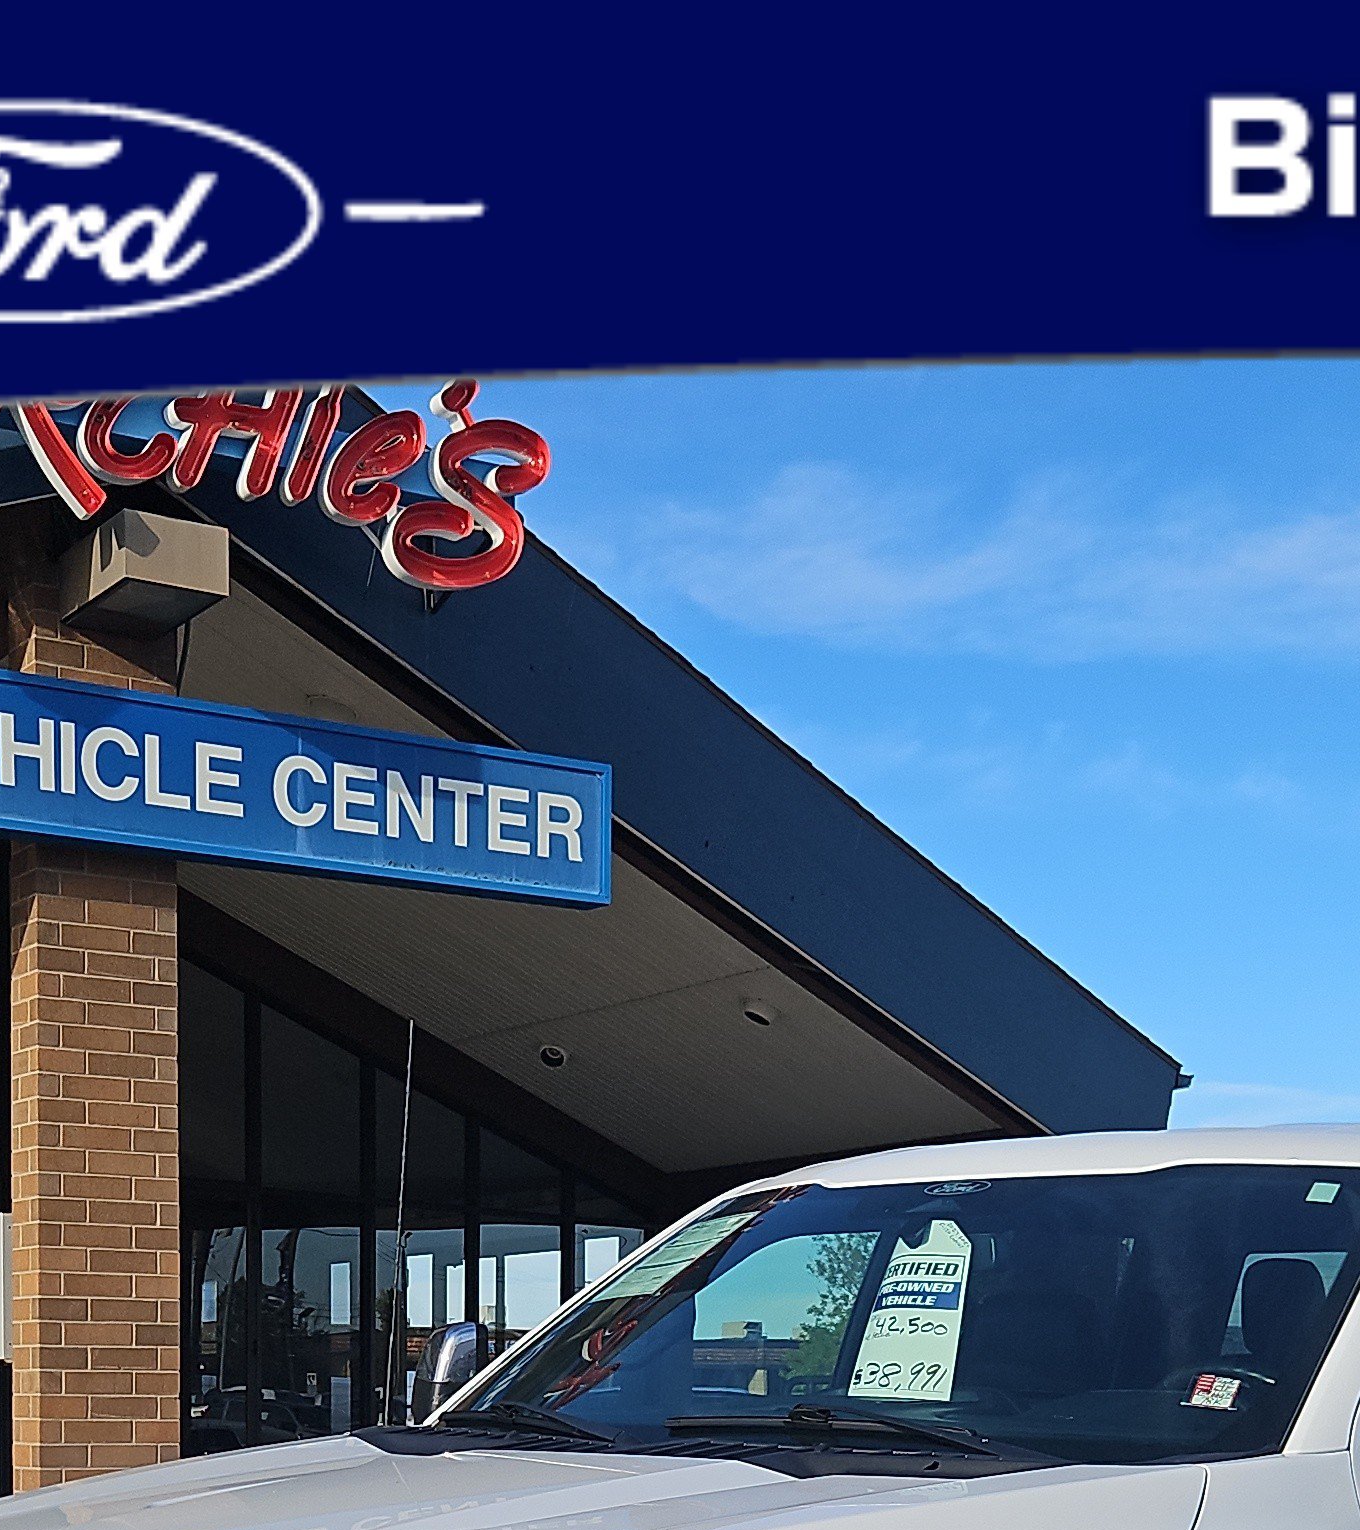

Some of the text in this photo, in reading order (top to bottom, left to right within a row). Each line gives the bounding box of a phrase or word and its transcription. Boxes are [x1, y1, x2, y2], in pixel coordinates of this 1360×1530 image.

[272, 754, 584, 862] CENTER
[884, 1261, 959, 1279] ERTIFIED
[881, 1295, 937, 1307] VEHICLE
[875, 1315, 948, 1336] 42,500
